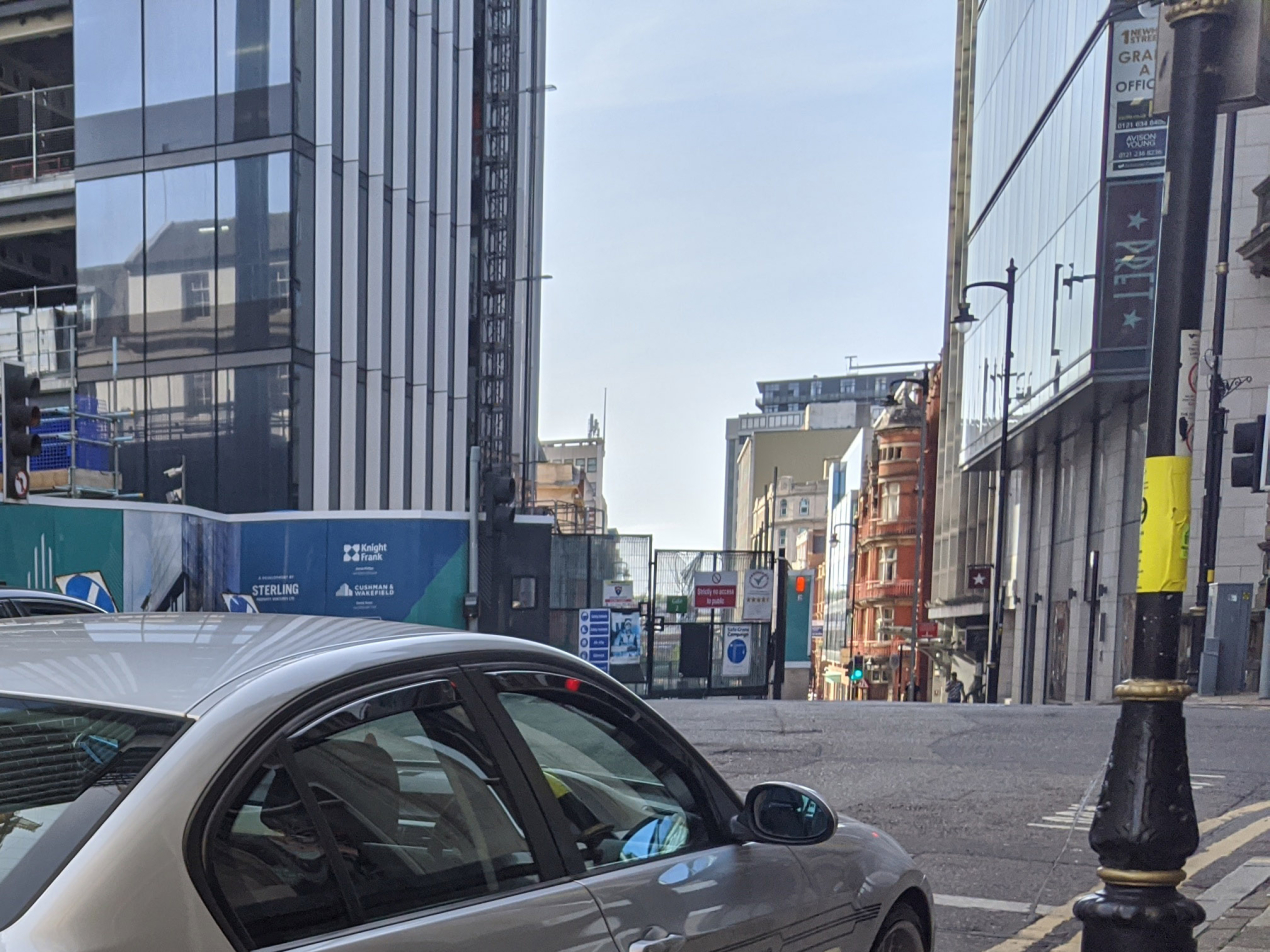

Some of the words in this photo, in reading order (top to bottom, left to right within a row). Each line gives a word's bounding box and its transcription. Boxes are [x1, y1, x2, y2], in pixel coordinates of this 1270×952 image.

[1118, 49, 1153, 63] GRA
[1139, 64, 1150, 76] A
[1115, 79, 1155, 93] OFFIC
[1126, 133, 1157, 141] AVISON
[1126, 139, 1155, 148] YOUNG
[1113, 239, 1157, 300] PRET
[360, 543, 387, 553] Knight
[360, 553, 384, 561] Frank
[251, 584, 300, 596] STERLING
